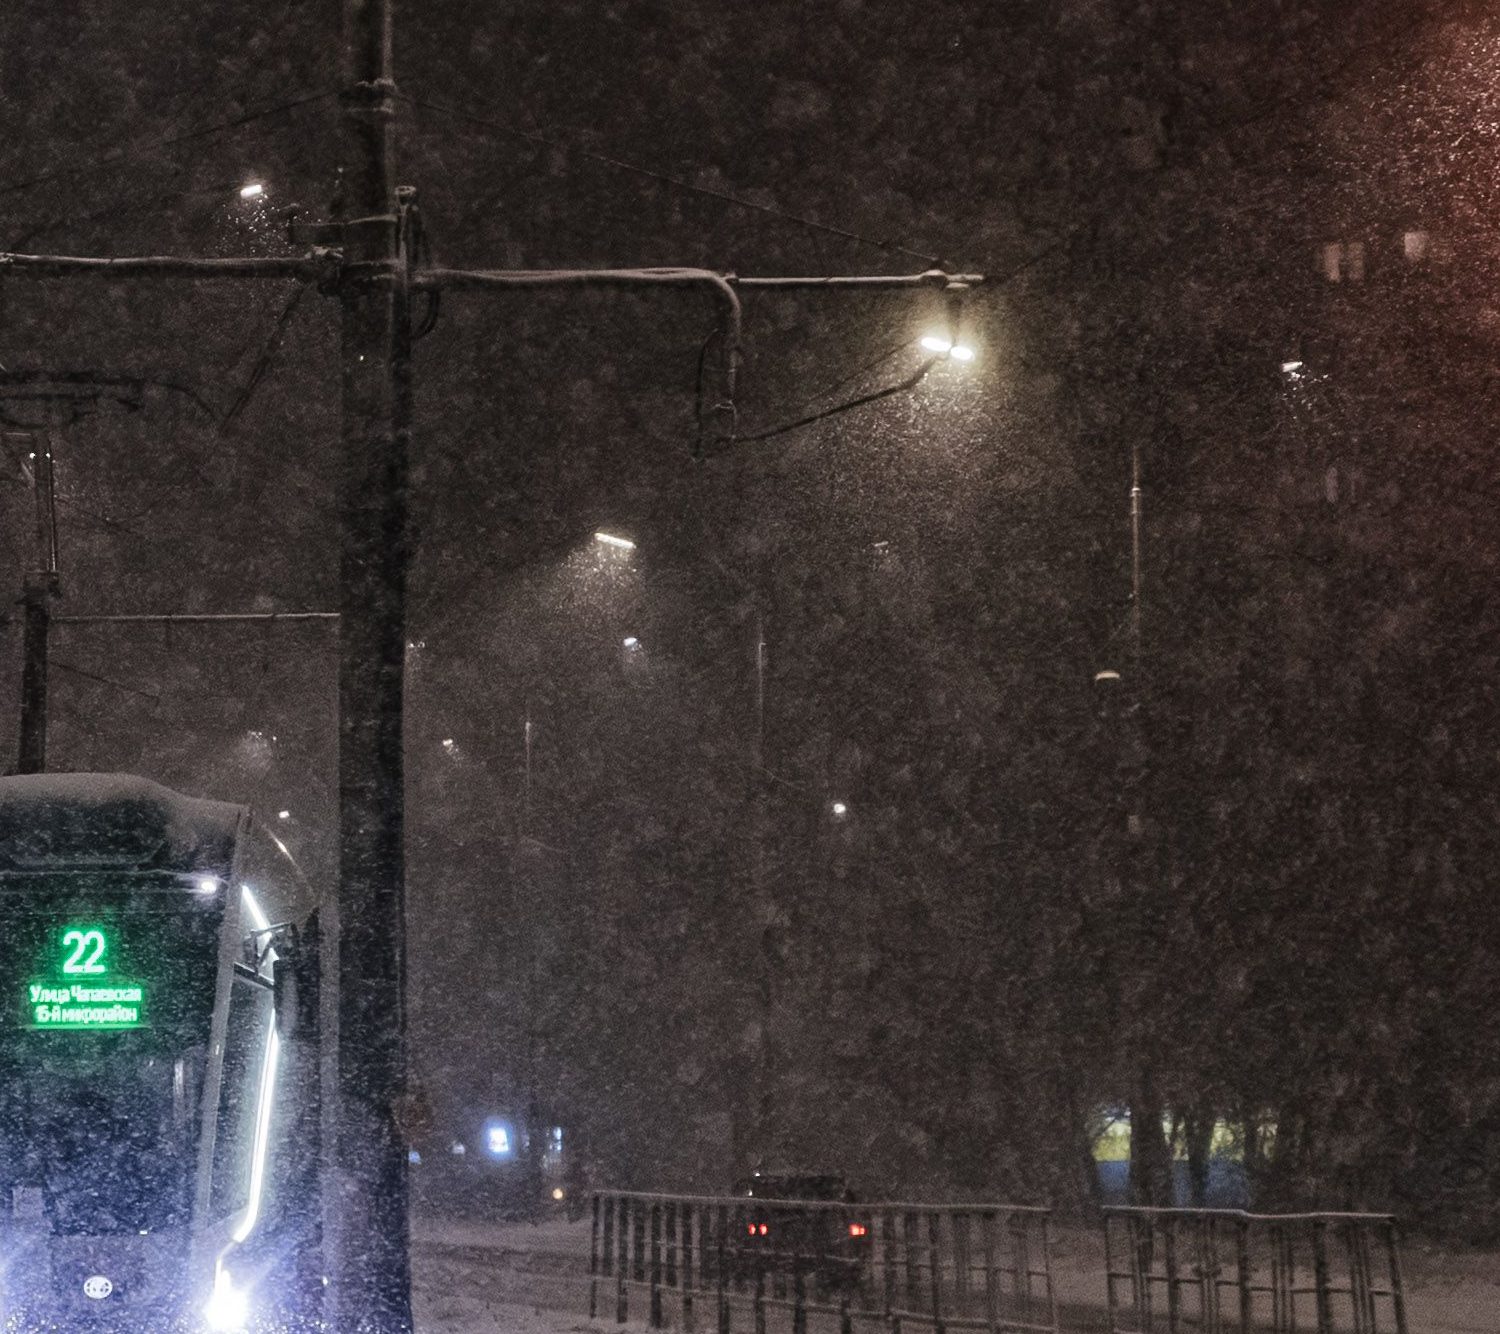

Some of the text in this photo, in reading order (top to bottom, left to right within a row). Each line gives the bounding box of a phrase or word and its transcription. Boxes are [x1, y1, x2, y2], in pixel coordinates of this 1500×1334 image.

[63, 931, 105, 973] 22
[29, 985, 70, 1004] Улица
[62, 1004, 137, 1023] микрорайон
